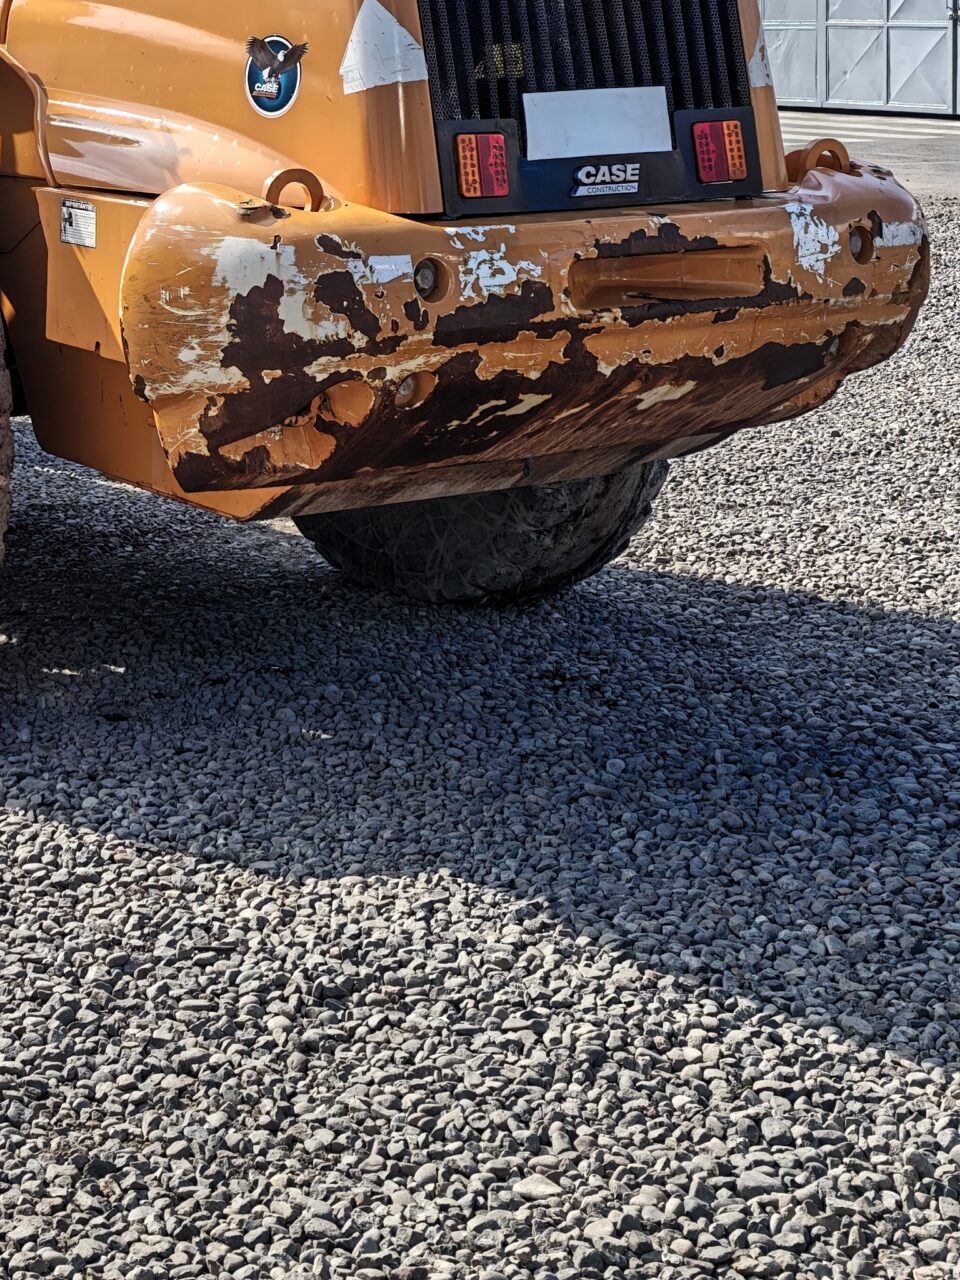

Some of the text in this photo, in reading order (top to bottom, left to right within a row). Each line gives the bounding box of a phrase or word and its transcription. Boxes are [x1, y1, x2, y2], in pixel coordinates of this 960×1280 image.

[254, 82, 279, 93] CASE
[577, 163, 640, 184] CASE
[586, 184, 637, 194] CONSTRUCTION
